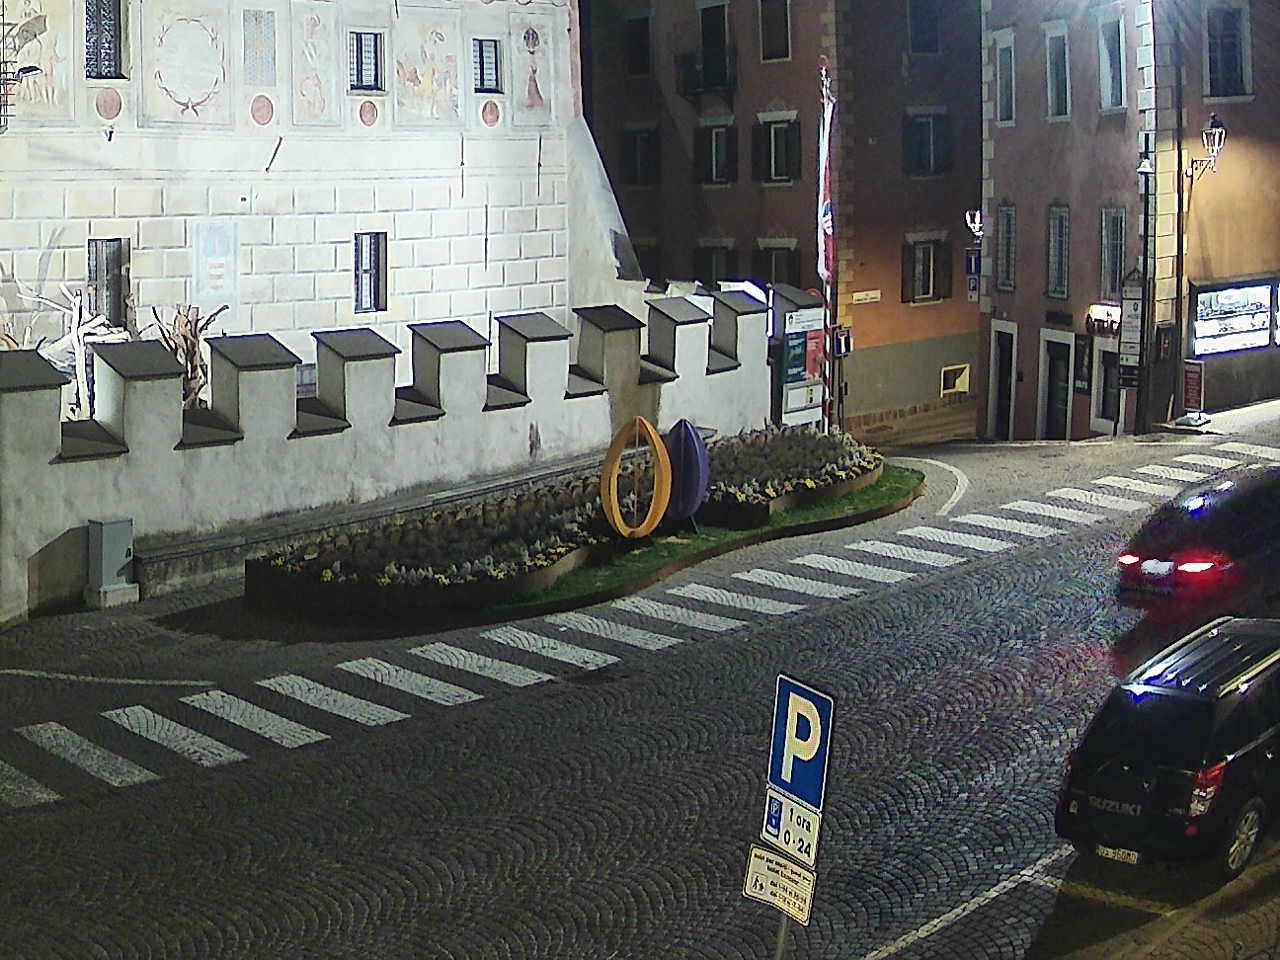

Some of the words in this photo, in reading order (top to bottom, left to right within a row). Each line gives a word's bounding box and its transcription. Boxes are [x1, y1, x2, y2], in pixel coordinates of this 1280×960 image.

[781, 692, 821, 783] P
[1088, 796, 1142, 816] SUZUKI
[789, 807, 794, 822] 1
[796, 815, 811, 833] ora
